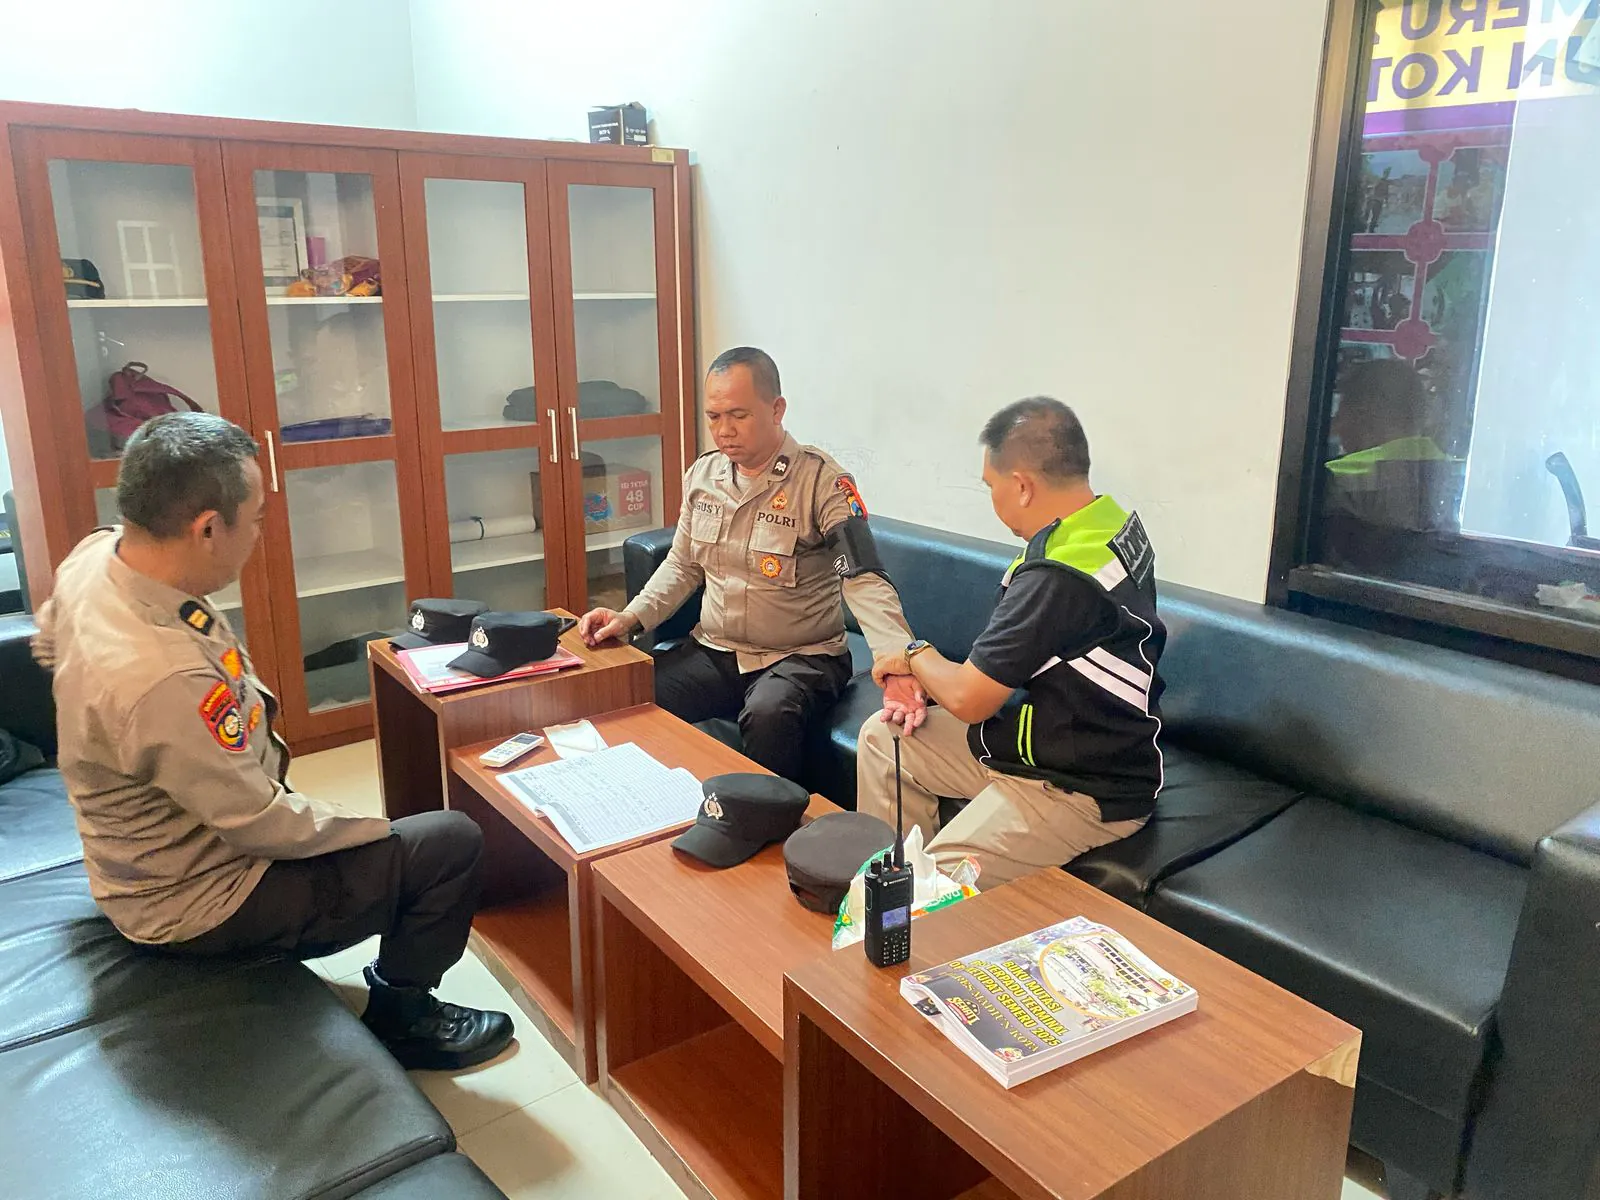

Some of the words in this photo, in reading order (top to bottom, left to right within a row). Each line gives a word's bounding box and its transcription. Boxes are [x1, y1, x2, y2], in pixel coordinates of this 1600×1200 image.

[626, 489, 644, 503] 48
[627, 503, 644, 511] CUP
[757, 511, 797, 528] POLRI
[987, 964, 1028, 998] TERPADU
[1020, 993, 1070, 1037] TERMINAL
[1003, 960, 1032, 982] BUKU
[1025, 980, 1064, 1013] MUTASI
[996, 993, 1038, 1029] SEMERU
[1030, 1027, 1062, 1047] 2025
